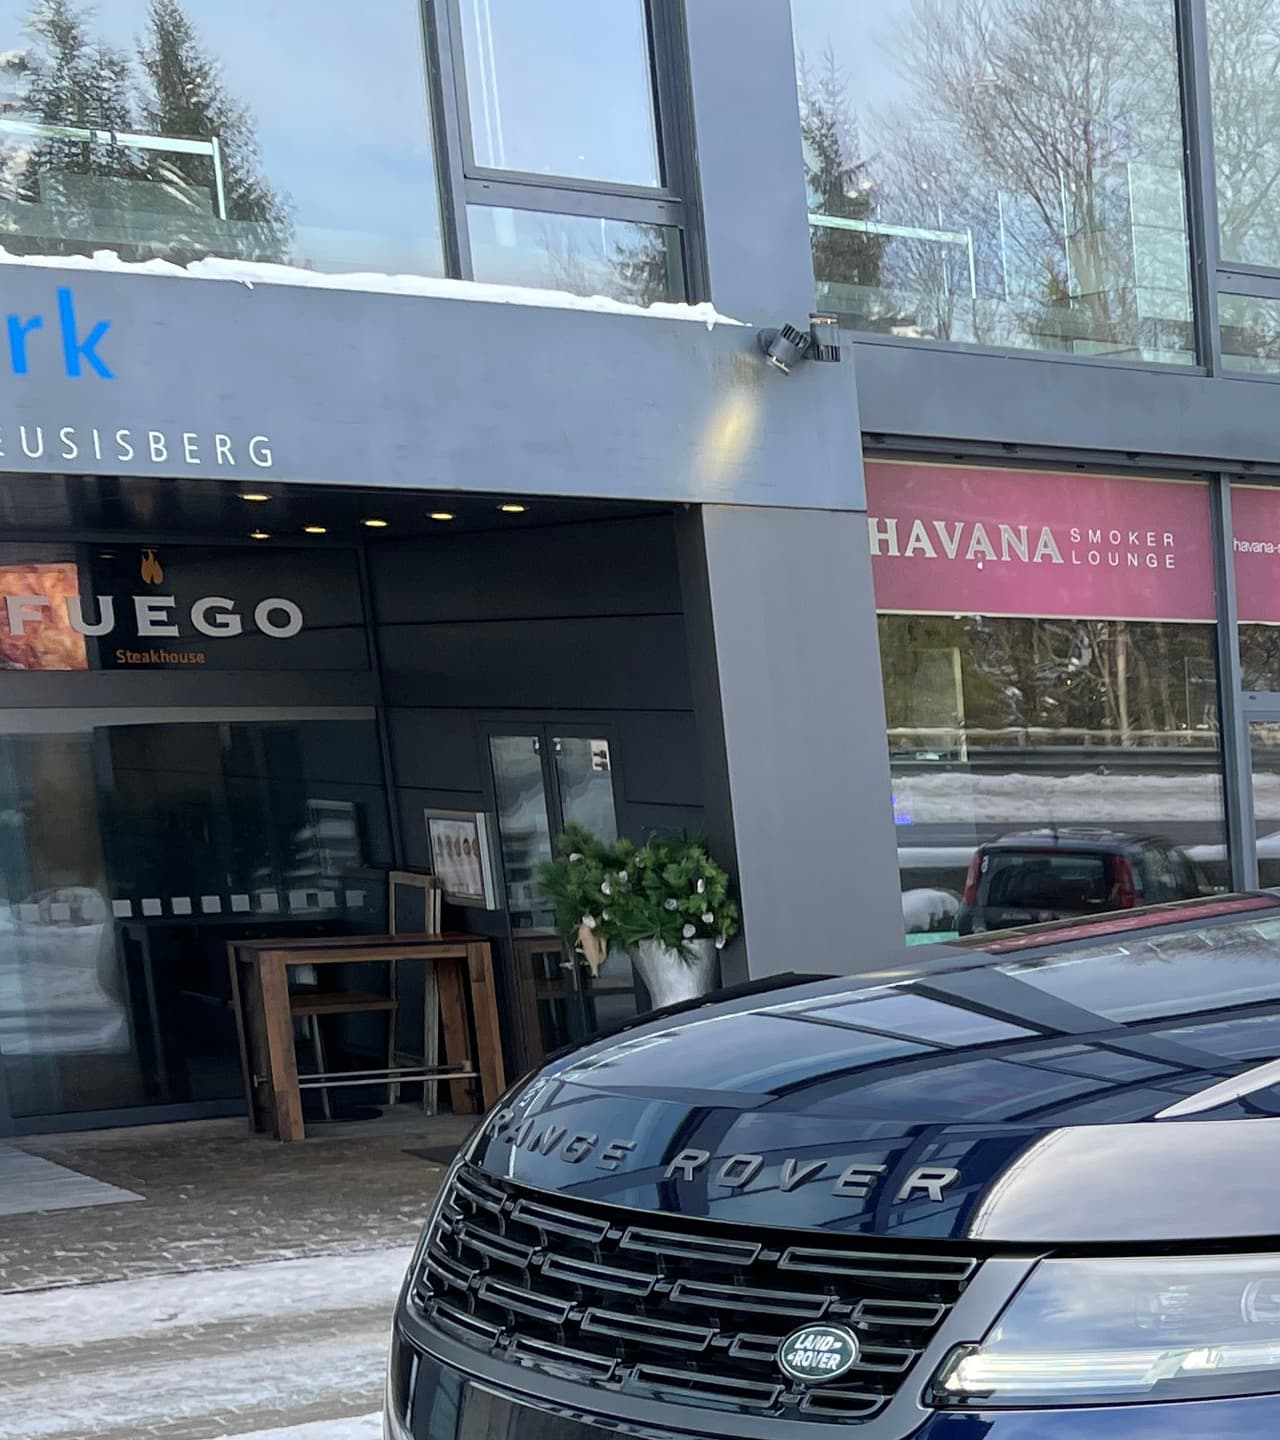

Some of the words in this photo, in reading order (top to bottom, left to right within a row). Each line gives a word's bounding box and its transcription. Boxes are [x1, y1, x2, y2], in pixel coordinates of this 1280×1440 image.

[0, 426, 273, 467] USISBERG
[867, 517, 1064, 564] HAVANA
[1070, 527, 1175, 548] SMOKER
[1071, 550, 1176, 569] LOUNGE
[5, 595, 303, 638] FUEGO
[116, 649, 206, 664] Steakhouse
[486, 1108, 637, 1171] RANGE
[663, 1148, 960, 1201] ROVER
[794, 1333, 835, 1351] LAND
[792, 1350, 841, 1370] ROVER
